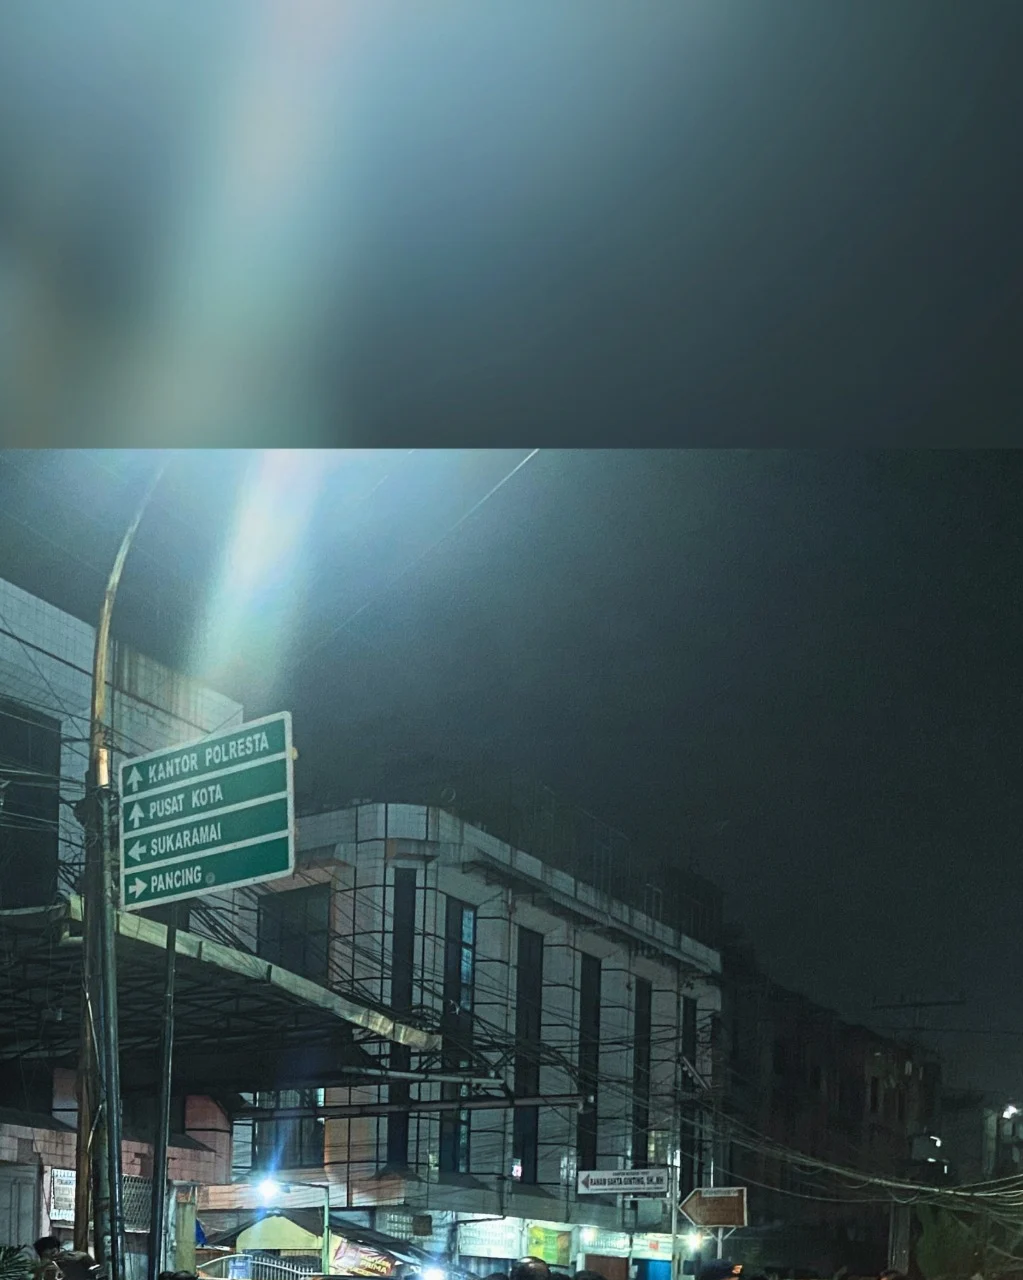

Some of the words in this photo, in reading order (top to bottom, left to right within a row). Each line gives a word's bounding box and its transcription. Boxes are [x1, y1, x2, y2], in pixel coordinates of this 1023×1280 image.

[148, 753, 198, 784] KANTOR
[205, 732, 269, 766] POLRESTA
[149, 793, 184, 819] PUSAT
[191, 784, 224, 808] KOTA
[150, 822, 222, 857] SUKARAMAI
[150, 865, 203, 893] PANCING
